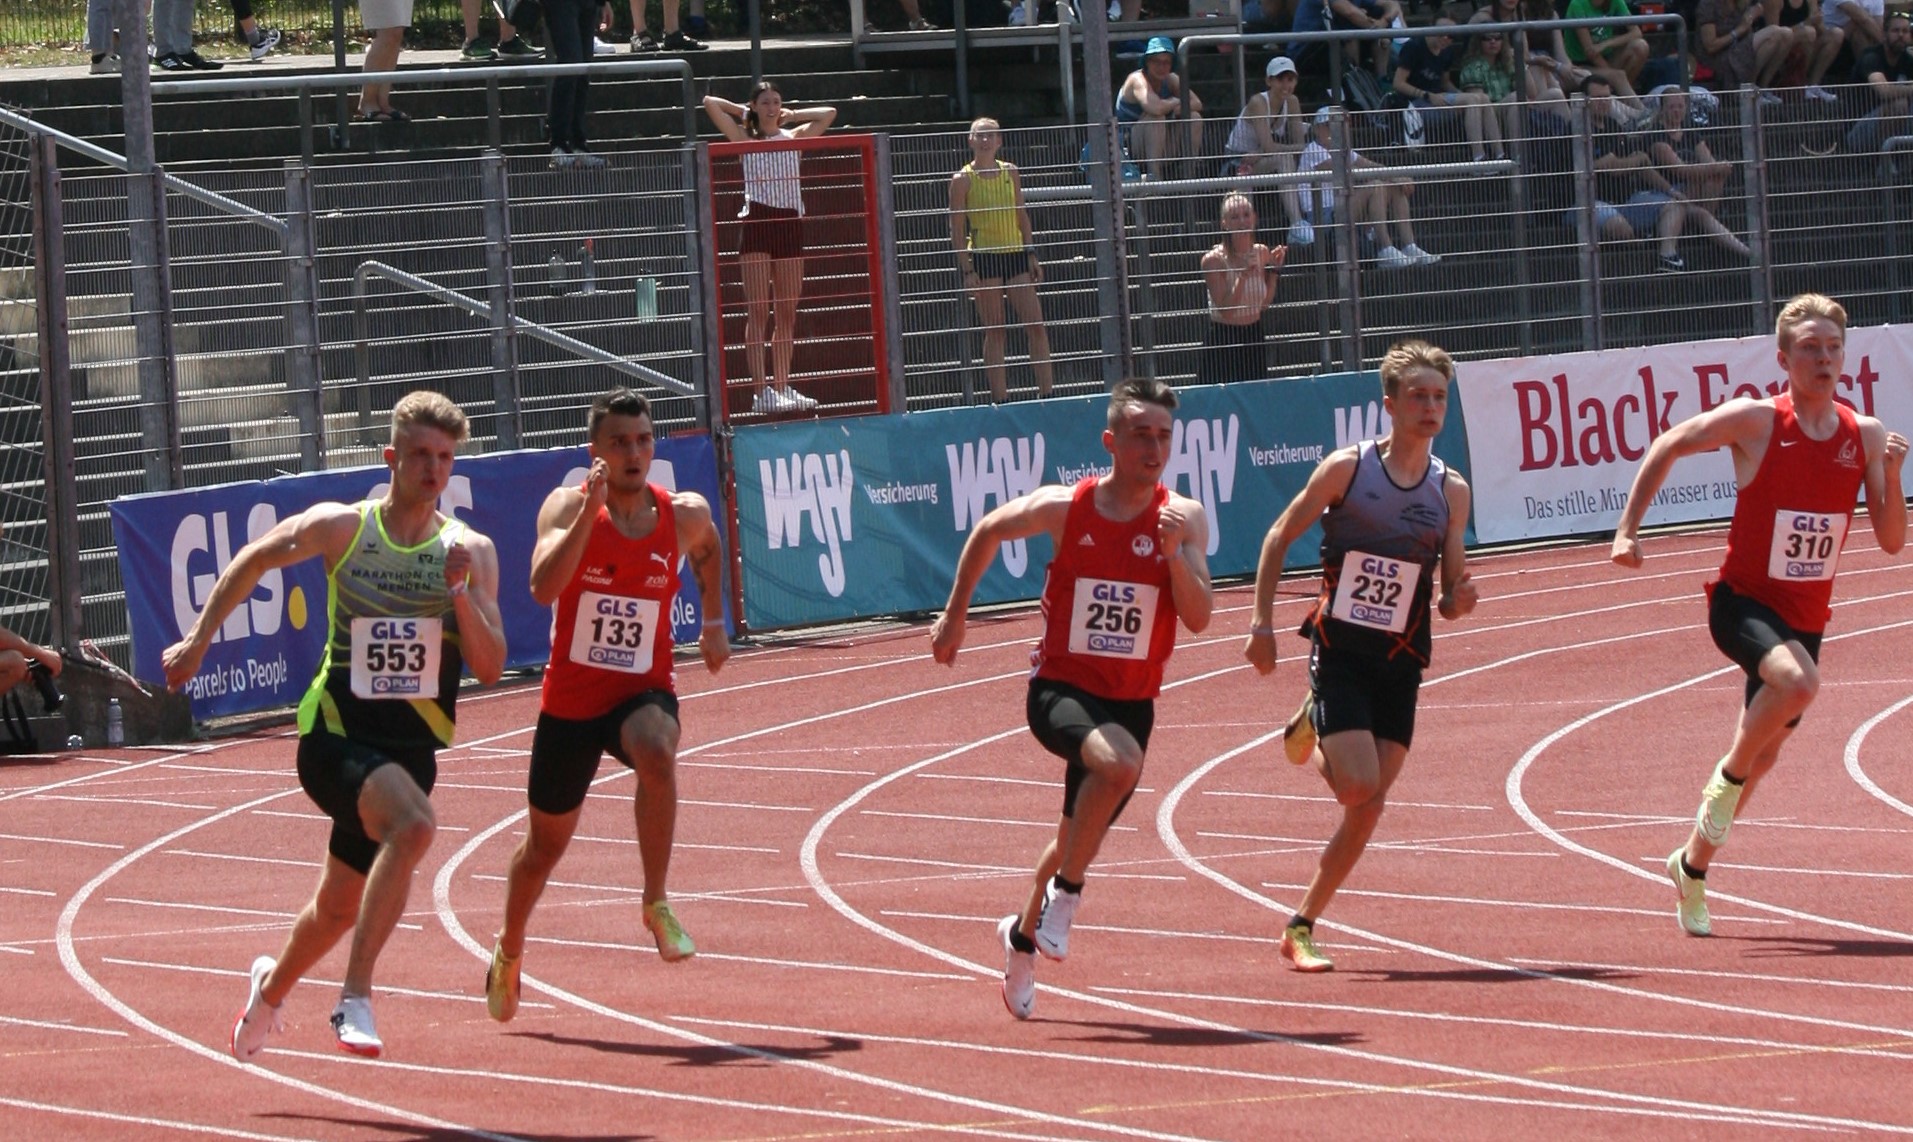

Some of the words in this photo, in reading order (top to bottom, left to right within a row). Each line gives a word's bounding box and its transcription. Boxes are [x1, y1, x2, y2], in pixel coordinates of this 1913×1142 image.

[1513, 365, 1678, 471] Black
[1249, 443, 1323, 467] Versicherung
[1056, 462, 1112, 486] Versicher
[864, 481, 938, 505] Versicherung
[1524, 496, 1553, 519] Das
[1557, 490, 1596, 516] stille
[1600, 482, 1708, 513] Minwasser
[1712, 480, 1738, 499] aus
[1785, 534, 1833, 560] 310
[351, 569, 422, 580] MARATHON
[377, 582, 431, 592] MENDEN
[1351, 575, 1402, 608] 232
[1085, 603, 1142, 634] 256
[591, 617, 643, 648] 133
[1107, 638, 1133, 649] PLAN
[367, 644, 426, 672] 553
[608, 650, 634, 662] PLAN
[185, 664, 228, 700] Parcels
[230, 664, 246, 692] to
[392, 679, 418, 688] PLAN
